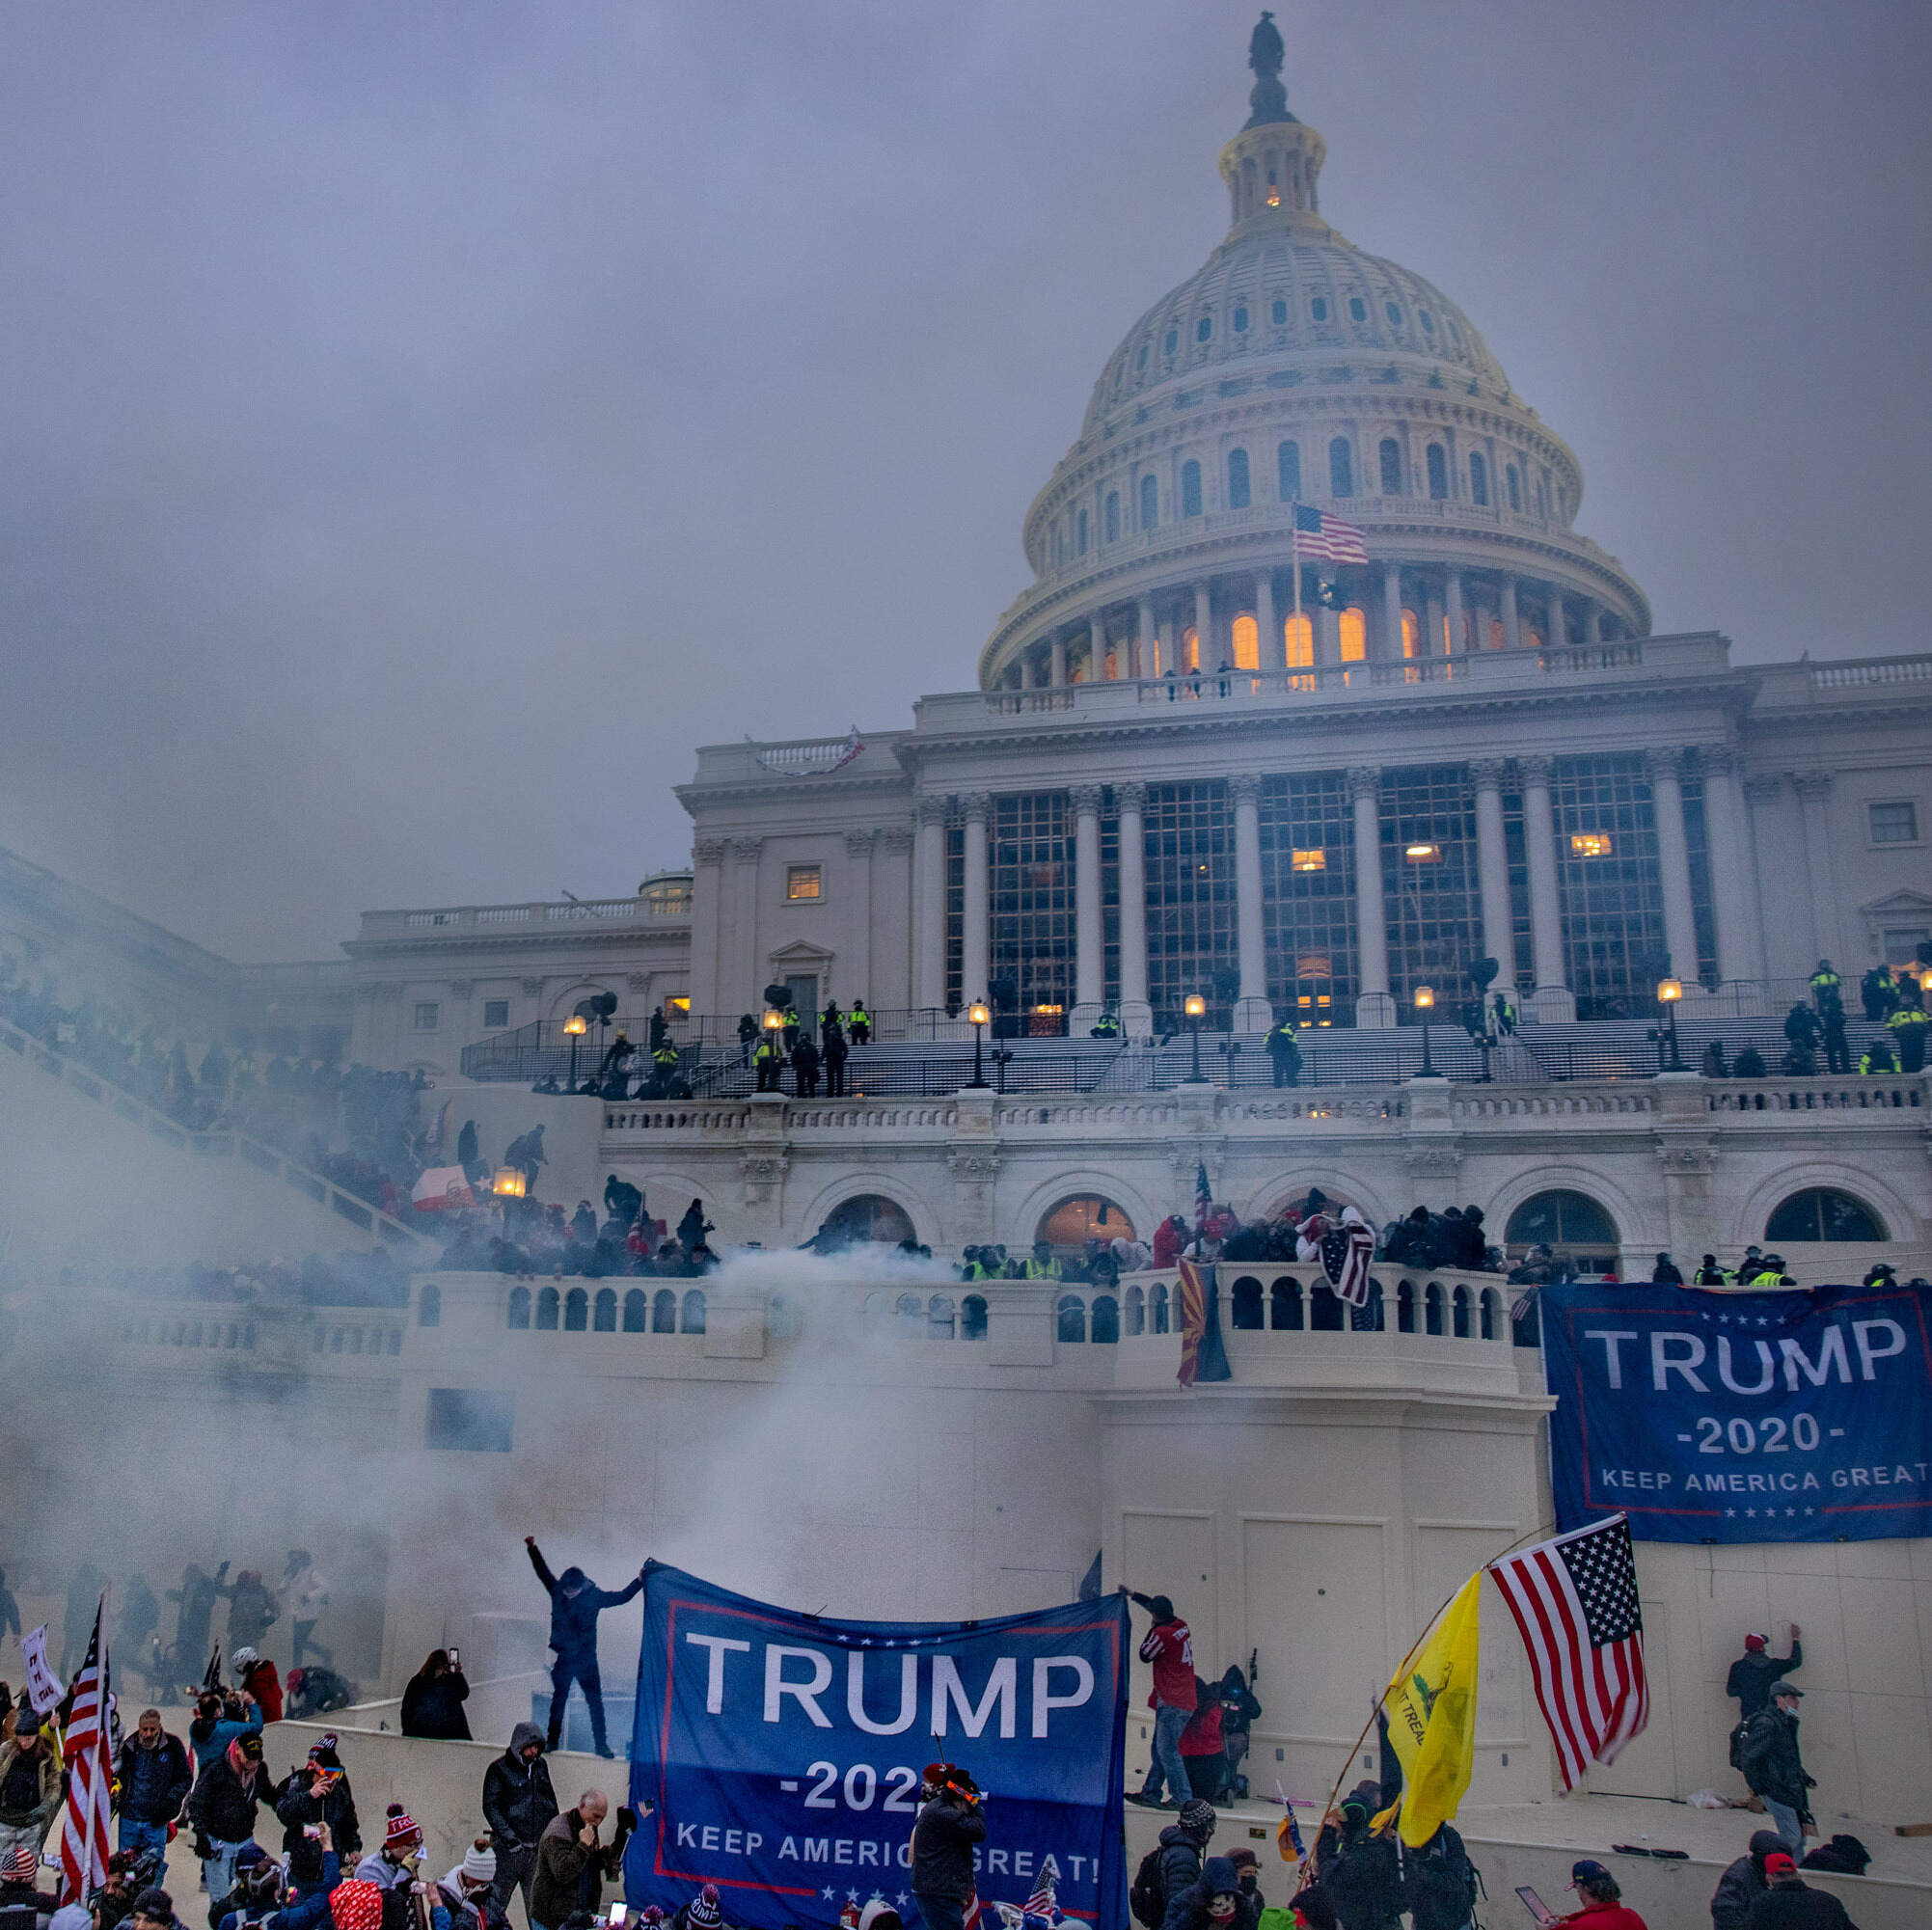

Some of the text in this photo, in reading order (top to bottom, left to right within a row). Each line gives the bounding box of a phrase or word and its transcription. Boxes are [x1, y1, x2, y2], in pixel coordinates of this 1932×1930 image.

[1585, 1318, 1907, 1396] TRUMP
[1602, 1468, 1673, 1490] KEEP
[1685, 1471, 1820, 1493] AMERICA
[686, 1632, 1095, 1739] TRUMP
[677, 1822, 763, 1856] KEEP
[777, 1835, 914, 1869] AMERIC
